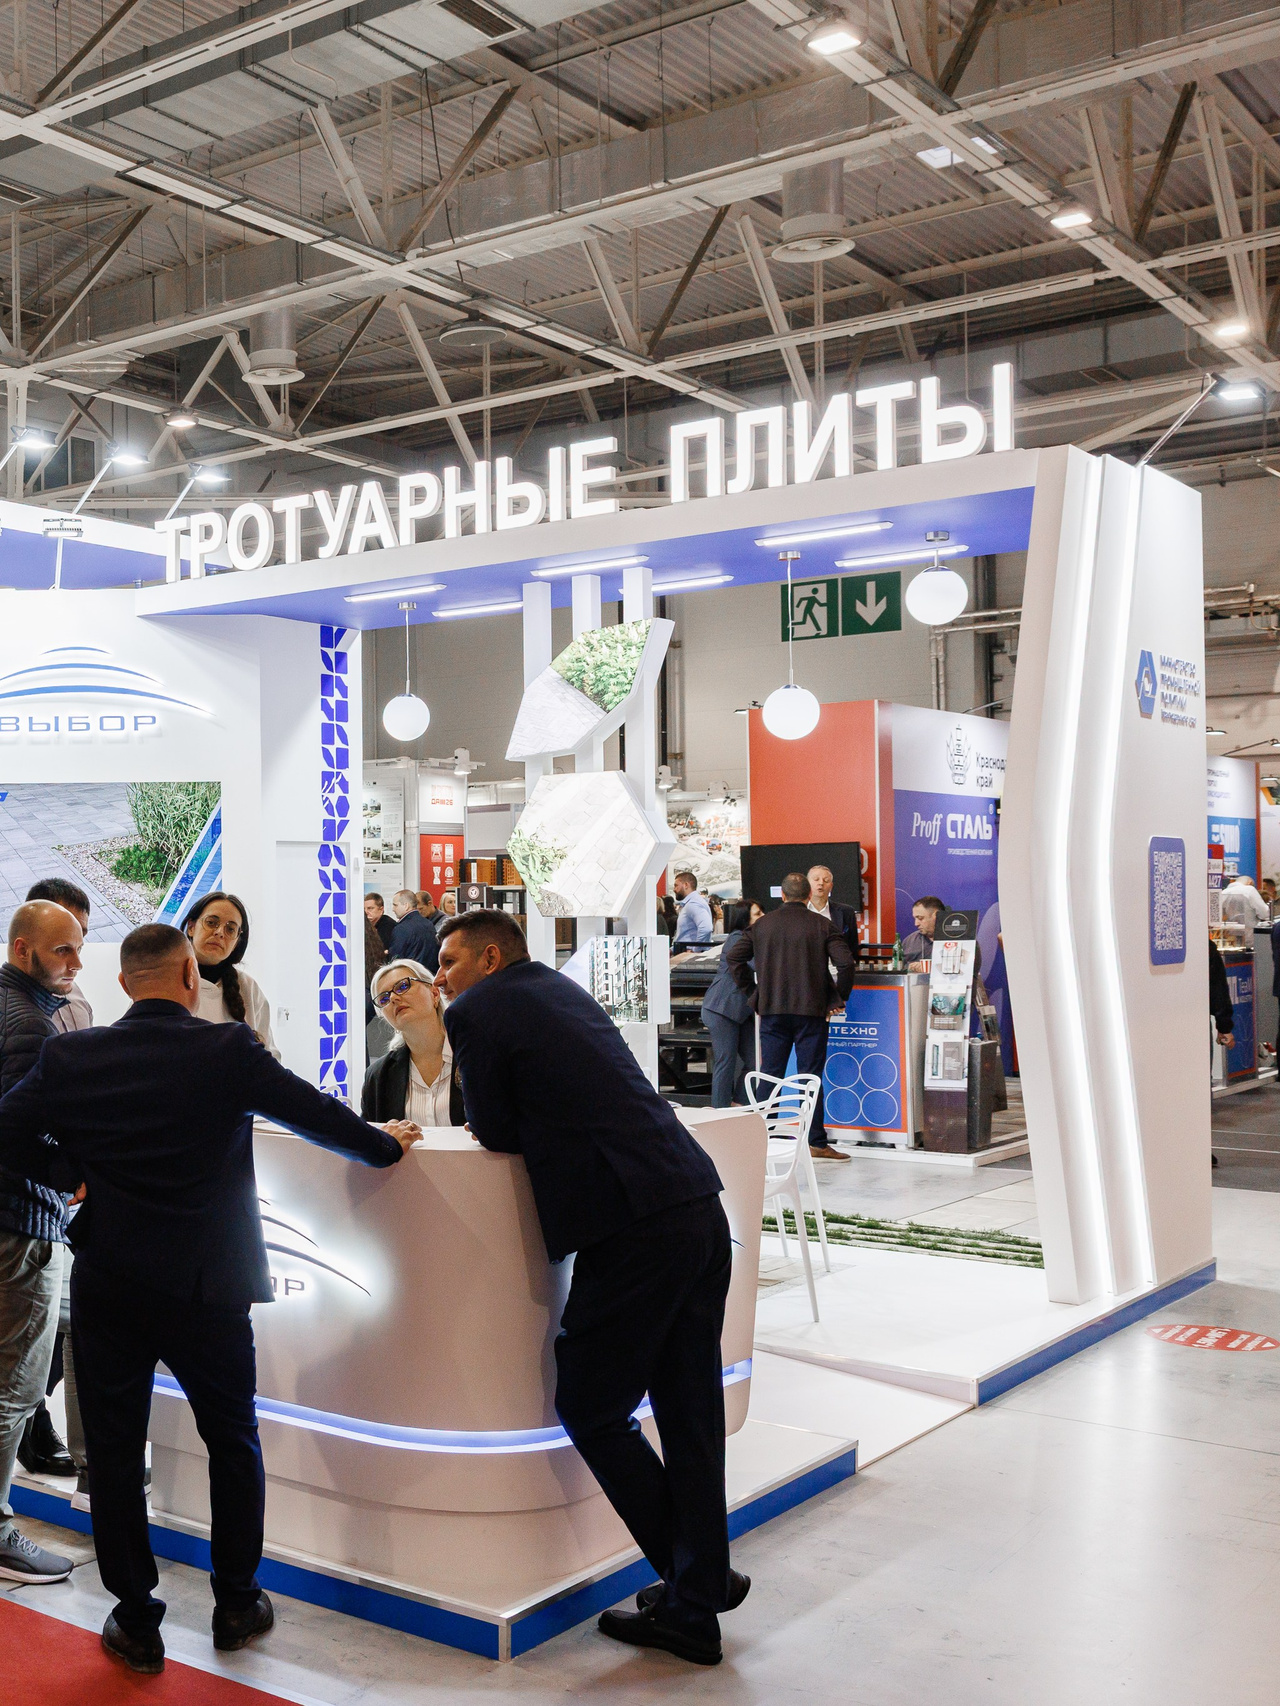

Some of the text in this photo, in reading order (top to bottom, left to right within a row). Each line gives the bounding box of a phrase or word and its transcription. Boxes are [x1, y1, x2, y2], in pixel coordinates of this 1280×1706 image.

[154, 361, 1015, 584] ТРОТУАРНЫЕ ПЛИТЫ
[976, 751, 1006, 775] Краснод
[976, 773, 993, 792] край
[911, 811, 993, 845] Proff СТАЛЬ
[828, 1026, 878, 1036] ТЕХНО
